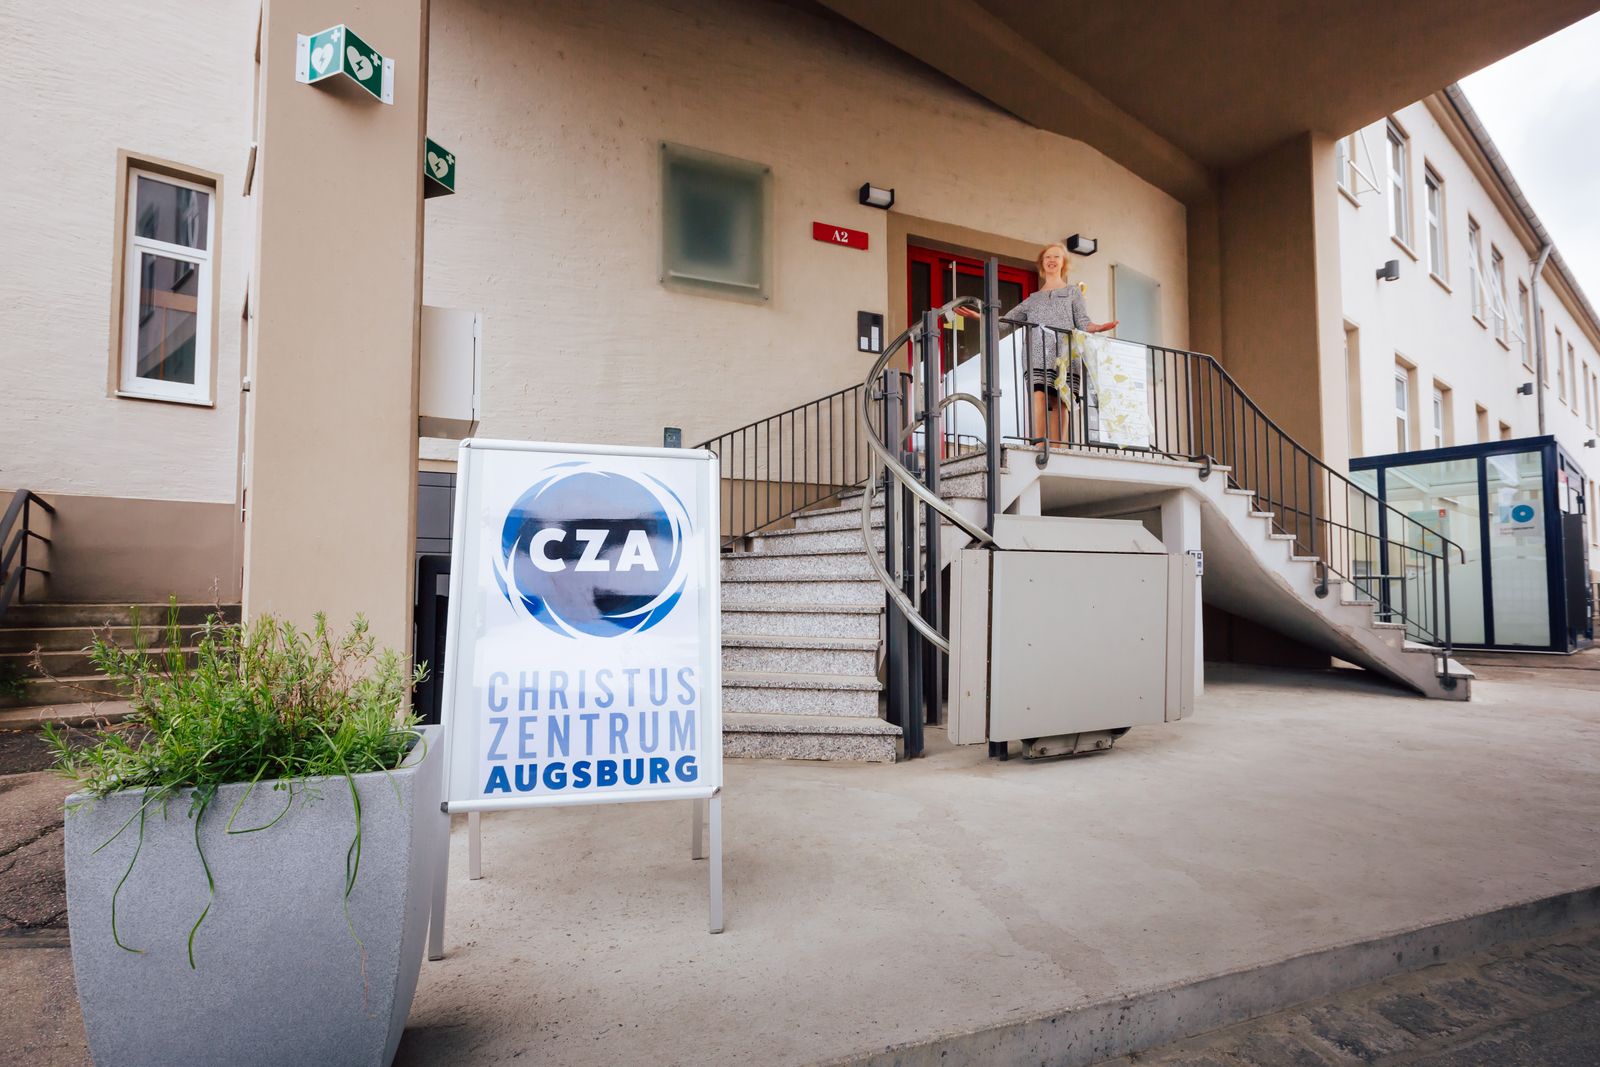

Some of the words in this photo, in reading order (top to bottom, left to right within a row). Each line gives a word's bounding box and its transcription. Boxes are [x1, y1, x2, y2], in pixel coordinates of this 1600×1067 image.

[832, 229, 849, 243] A2
[529, 528, 659, 573] CZA
[487, 666, 697, 713] CHRISTUS
[486, 710, 697, 761] ZENTRUM
[483, 755, 699, 794] AUGSBURG
